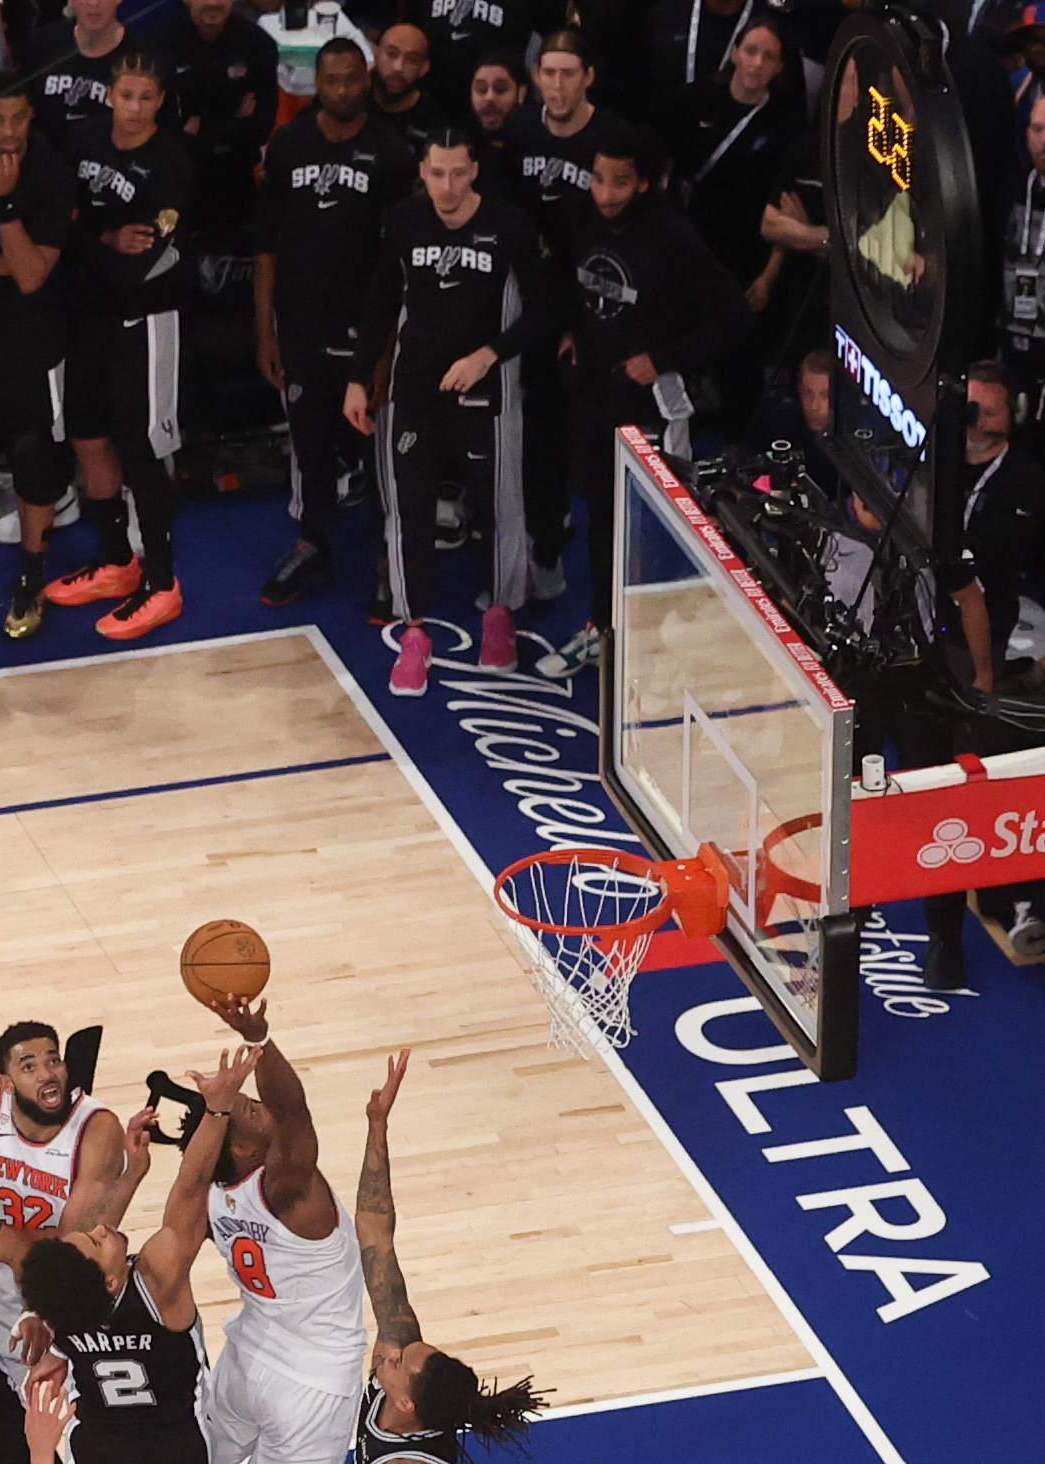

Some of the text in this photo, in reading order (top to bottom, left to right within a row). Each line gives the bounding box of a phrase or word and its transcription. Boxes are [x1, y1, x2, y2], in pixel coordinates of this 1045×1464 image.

[675, 995, 991, 1324] ULTRA
[231, 1236, 277, 1299] 8
[66, 1331, 152, 1352] HARPER
[92, 1359, 158, 1408] 2
